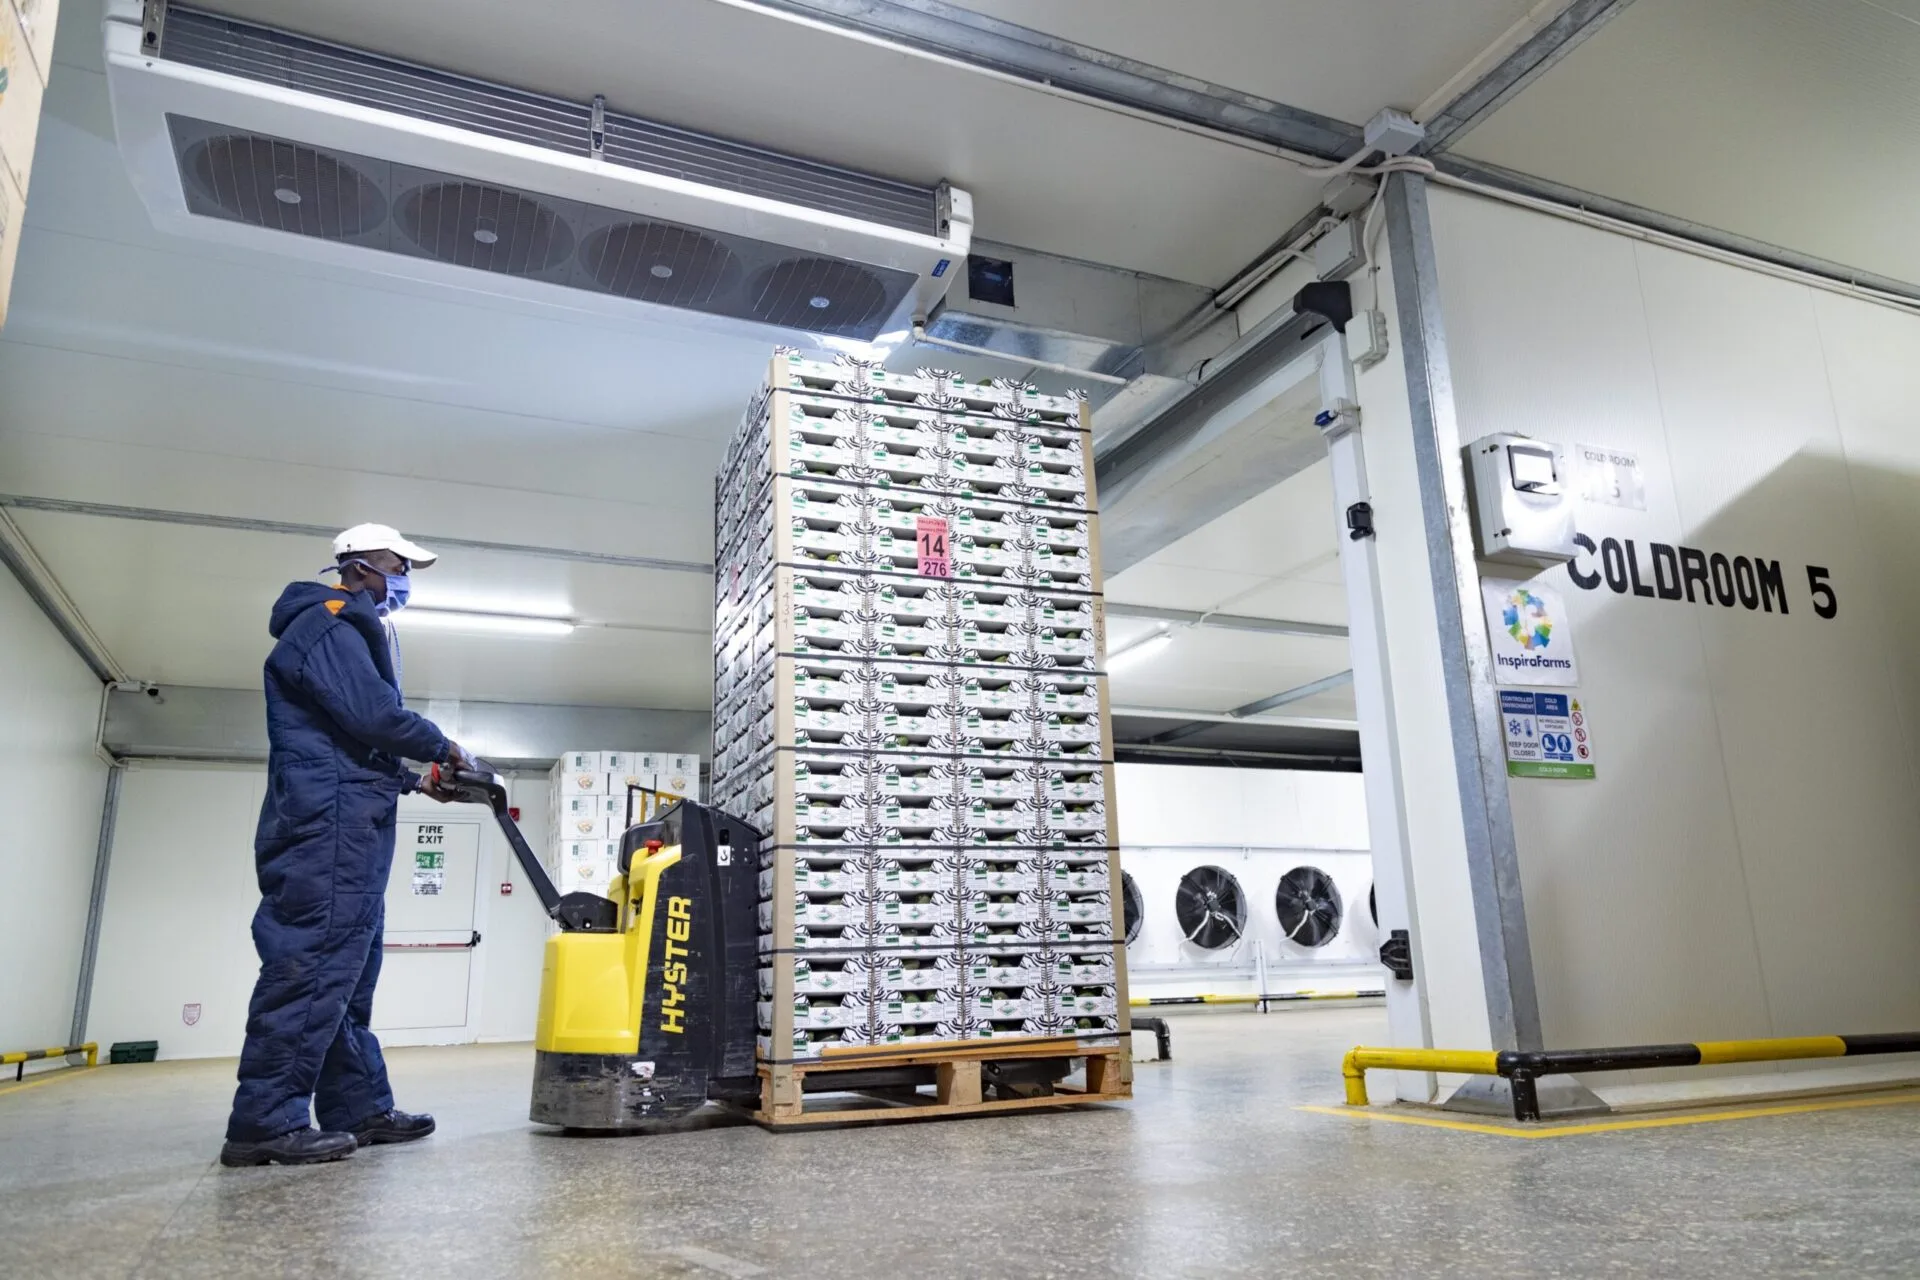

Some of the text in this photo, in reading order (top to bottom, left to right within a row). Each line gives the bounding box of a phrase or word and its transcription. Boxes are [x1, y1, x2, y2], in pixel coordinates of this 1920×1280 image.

[921, 533, 945, 557] 14
[924, 561, 947, 576] 276
[1567, 533, 1837, 620] COLDROOM 5
[1497, 653, 1571, 669] InspiraFarms
[1502, 696, 1533, 704] CONTROLLED
[418, 825, 444, 834] FIRE
[417, 835, 444, 845] EXIT
[660, 896, 692, 1034] HYSTER
